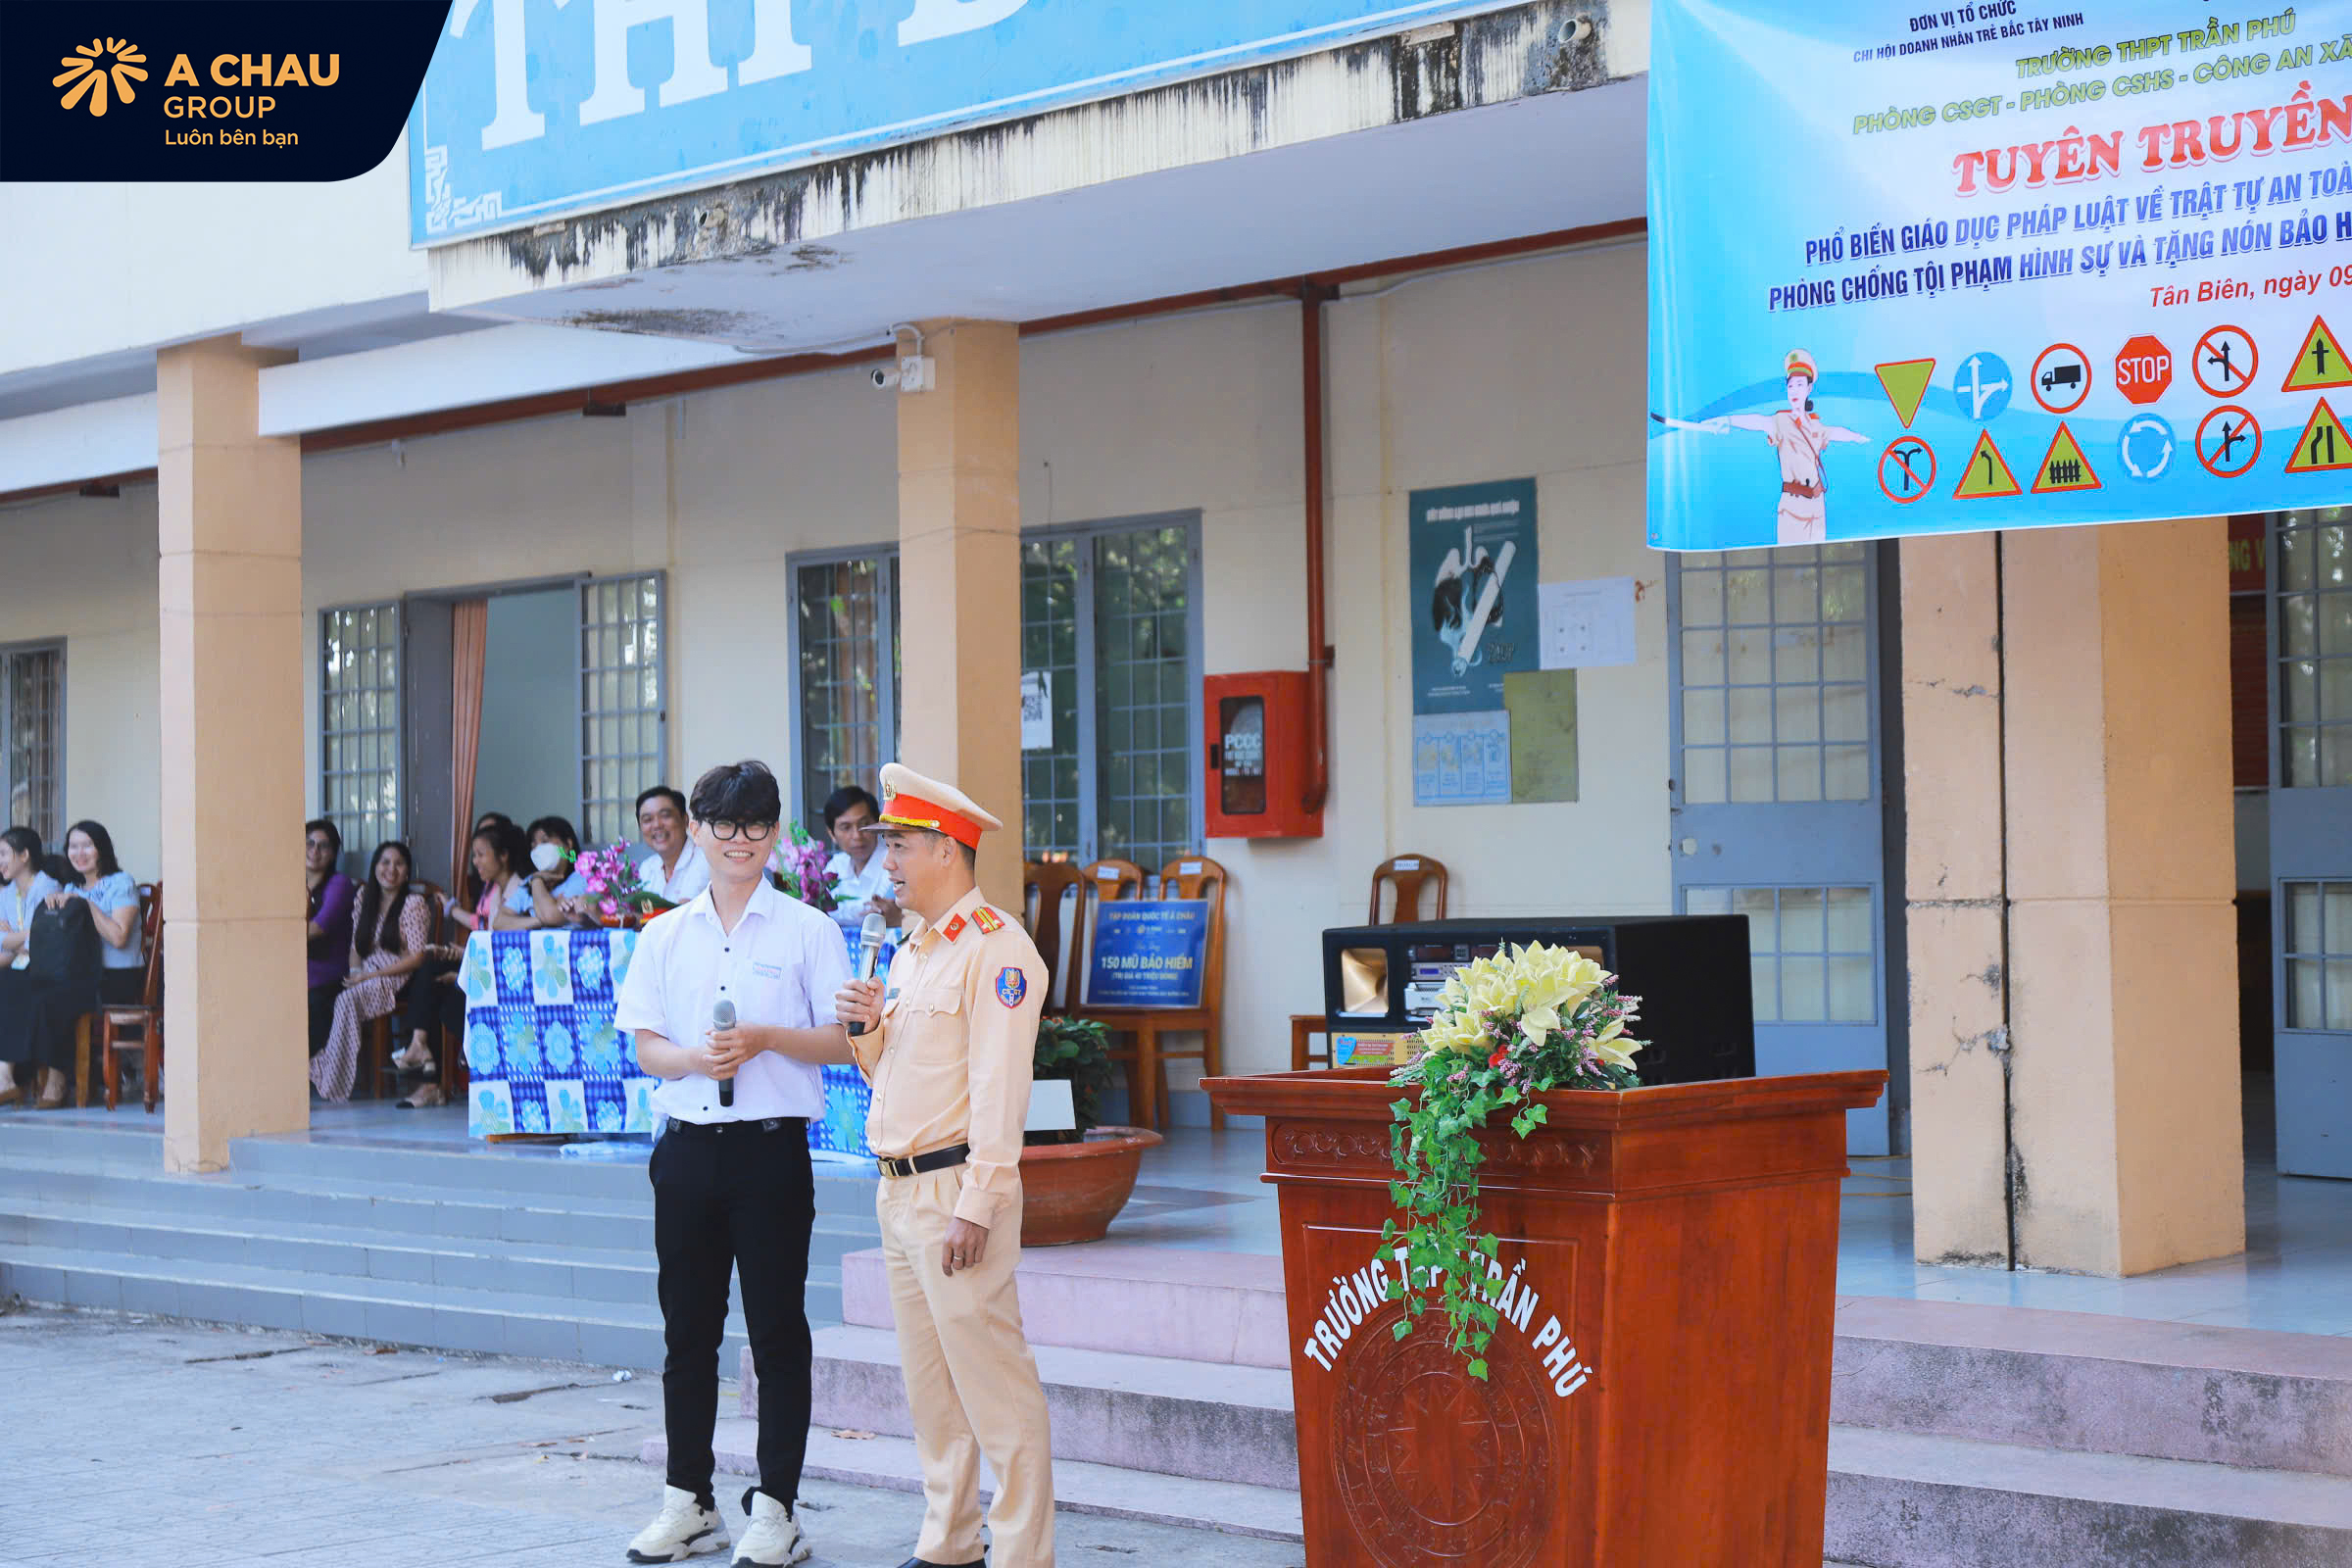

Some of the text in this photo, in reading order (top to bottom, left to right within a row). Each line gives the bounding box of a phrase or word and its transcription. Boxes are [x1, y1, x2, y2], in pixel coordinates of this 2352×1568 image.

[1853, 13, 2084, 63] CHI HỘI DOANH NHÂN TRẺ BẮC TÂY NINH
[1910, 14, 1938, 31] ĐƠN
[1941, 11, 1955, 28] VỊ
[1957, 1, 1975, 24] TỔ
[2015, 8, 2297, 78] TRƯỜNG THPT TRẦN PHÚ
[1853, 106, 1936, 134] PHÒNG
[1941, 95, 2003, 122] CSGT
[2020, 80, 2107, 111] PHÒNG
[2112, 69, 2174, 97] CSHS
[2193, 53, 2271, 83] CÔNG
[2276, 45, 2313, 71] AN
[2319, 34, 2352, 64] XÃ
[1953, 80, 2352, 195] TUYÊN TRUYỀN
[1806, 226, 1843, 266] PHỔ
[1850, 222, 1895, 259] BIẾN
[1900, 219, 1948, 252] GIÁO
[1955, 215, 2000, 248] DỤC
[2007, 204, 2067, 238] PHÁP
[2074, 195, 2130, 231] LUẬT
[2136, 185, 2164, 222] VỀ
[2171, 181, 2227, 220] TRẬT
[2233, 176, 2265, 214] TỰ
[2268, 173, 2302, 206] AN
[1769, 278, 1836, 313] PHÒNG
[1841, 265, 1908, 302] CHỐNG
[1913, 261, 1944, 297] TỘI
[1951, 256, 2012, 290] PHẠM
[2020, 247, 2074, 280] HÌNH
[2081, 239, 2113, 275] SỰ
[2119, 234, 2146, 268] VÀ
[2154, 229, 2215, 268] TẶNG
[2222, 219, 2273, 256] NÓN
[2279, 208, 2328, 248] BẢO
[2150, 278, 2189, 308] Tân
[2197, 278, 2255, 302] Biên,
[2263, 269, 2323, 298] ngày
[2118, 354, 2170, 385] STOP
[1102, 956, 1119, 969] 150
[1303, 1258, 1390, 1372] TRƯỜNG
[1532, 1315, 1593, 1397] PHÚ
